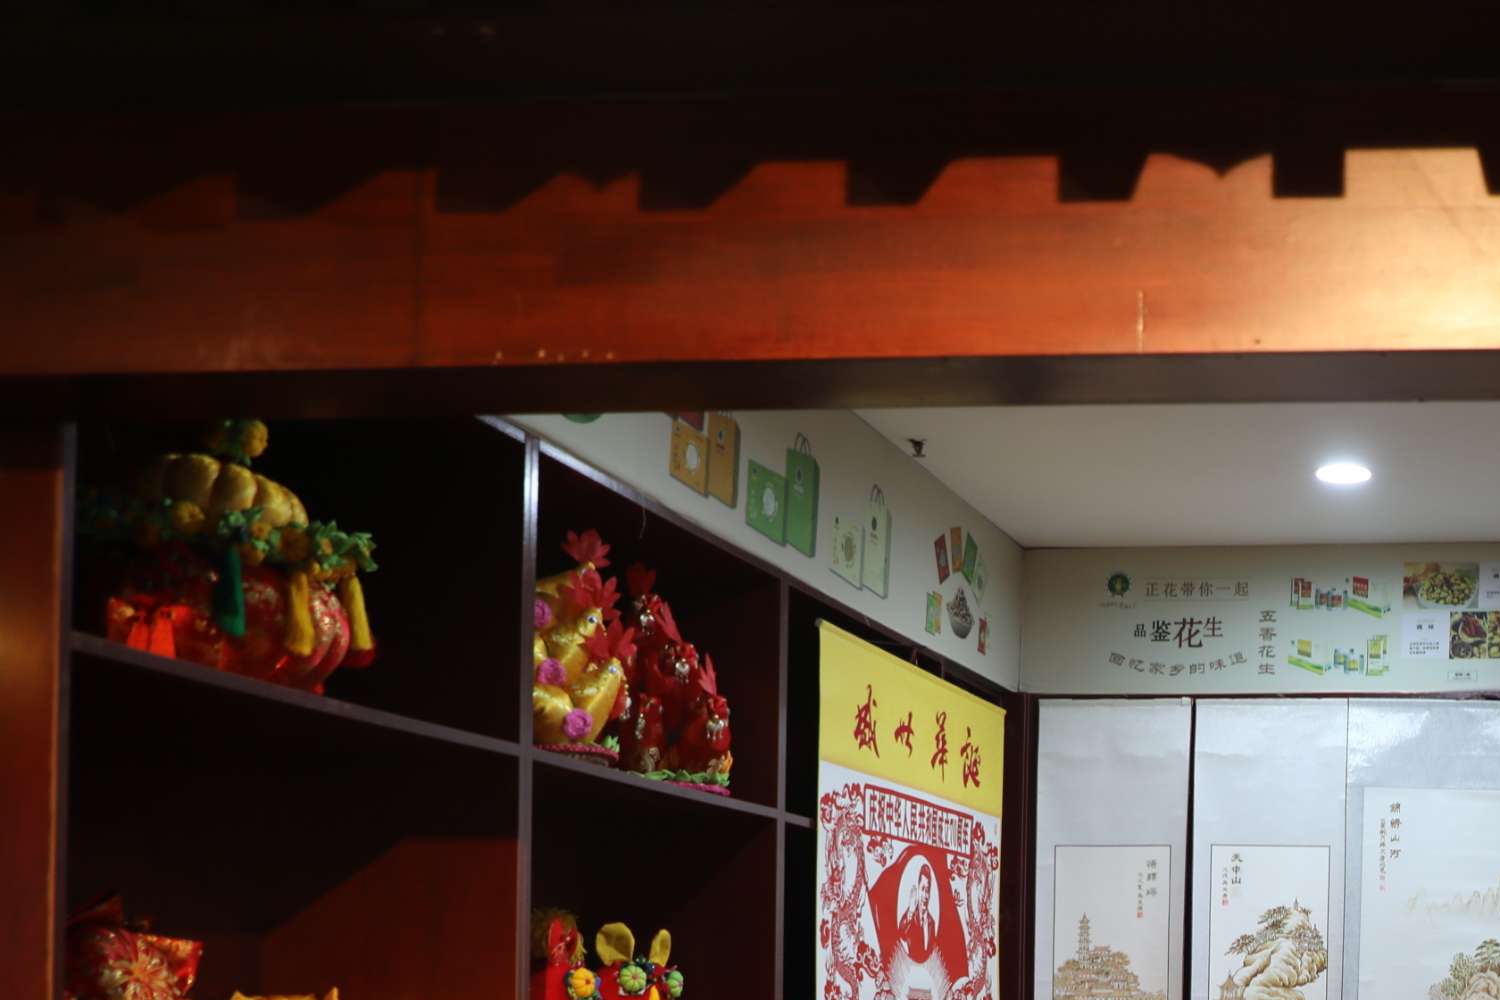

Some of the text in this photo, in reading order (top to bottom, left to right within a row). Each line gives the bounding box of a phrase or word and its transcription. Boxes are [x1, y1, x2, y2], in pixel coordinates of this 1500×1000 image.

[1133, 615, 1225, 649] 品鉴花生
[1257, 609, 1278, 676] 五香花生
[1107, 650, 1249, 678] 回忆家乡的味道
